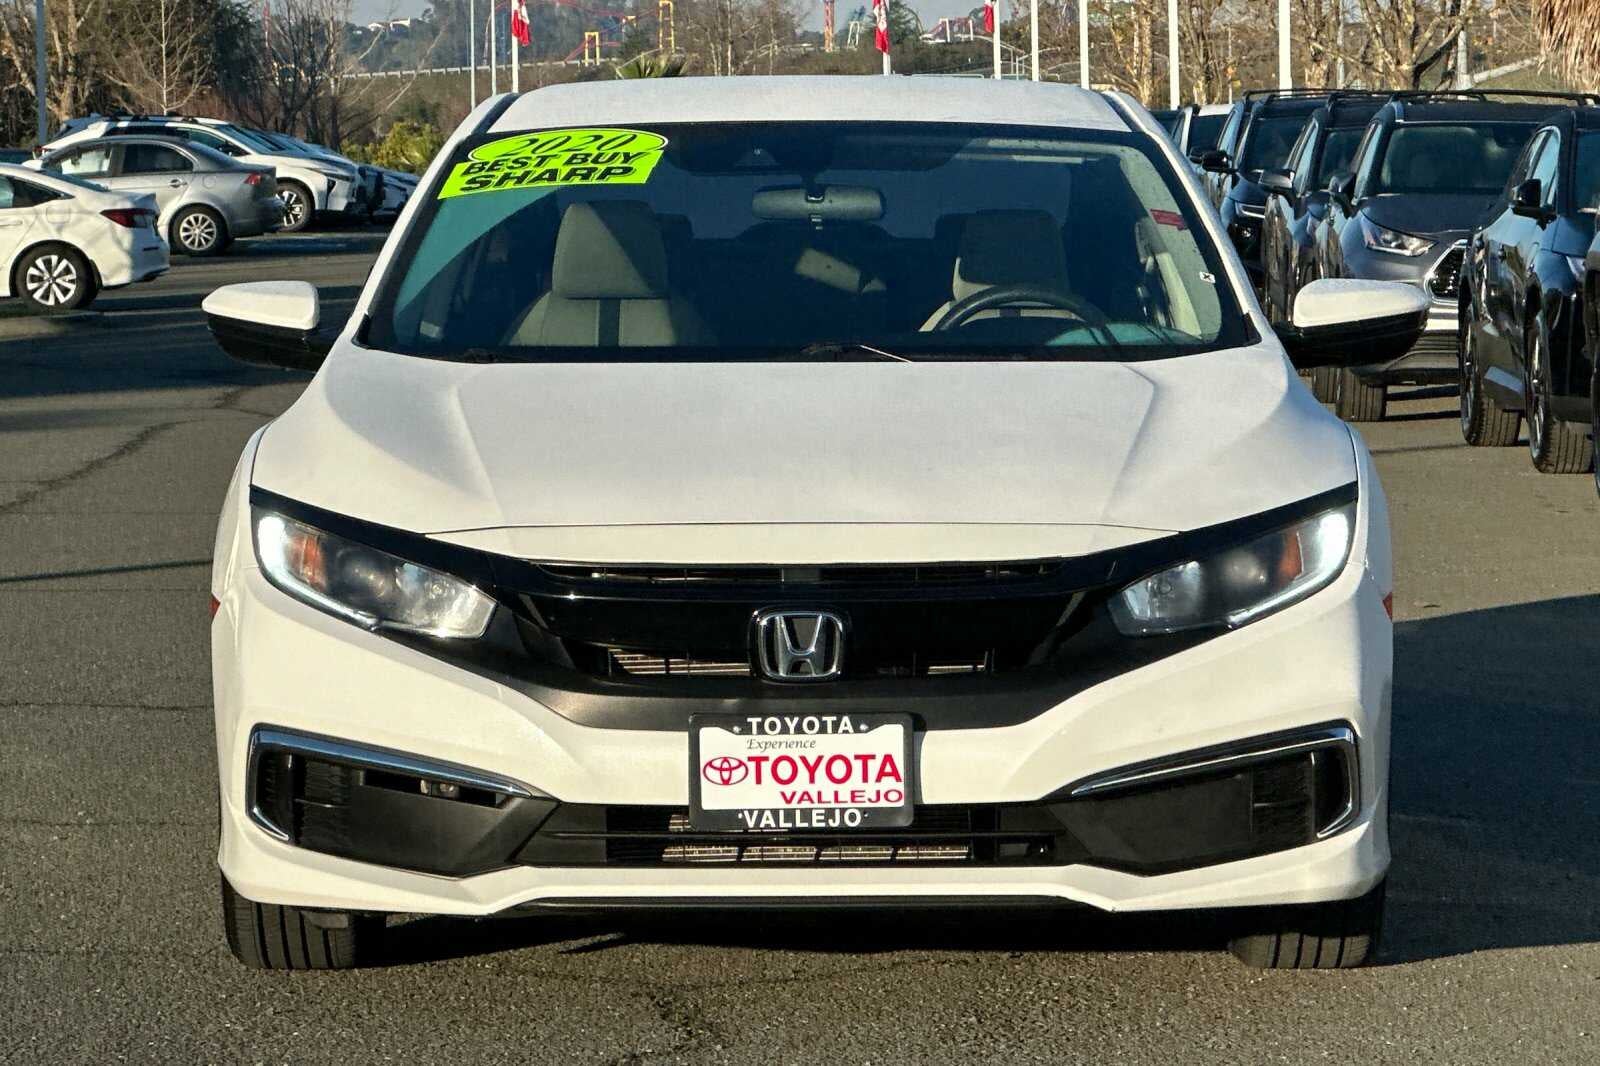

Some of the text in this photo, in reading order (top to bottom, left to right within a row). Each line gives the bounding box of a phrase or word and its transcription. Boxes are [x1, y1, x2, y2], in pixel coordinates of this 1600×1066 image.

[496, 133, 638, 157] 2020
[461, 151, 648, 177] BEST BUY
[459, 166, 635, 192] SHARP
[746, 716, 855, 736] TOYOTA
[746, 738, 816, 752] Experience
[747, 754, 903, 786] TOYOTA
[780, 789, 904, 805] VALLEJO
[743, 808, 863, 828] VALLEJO
